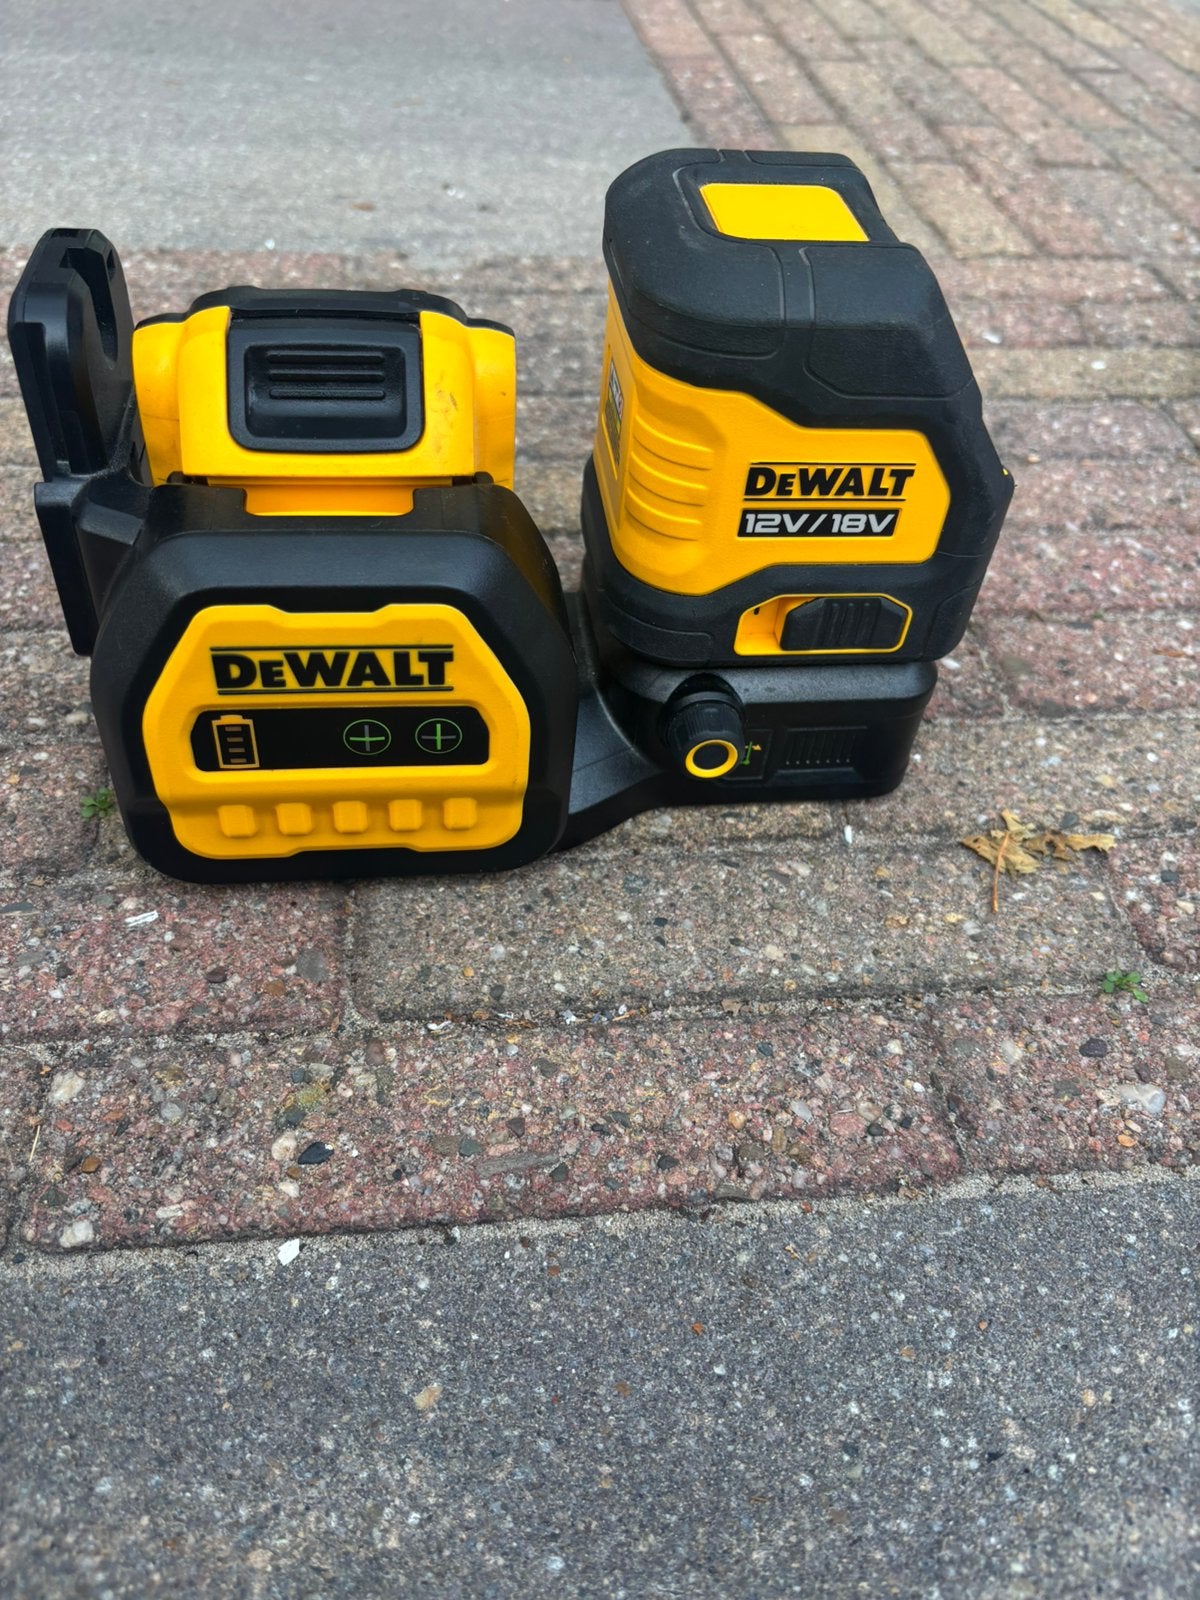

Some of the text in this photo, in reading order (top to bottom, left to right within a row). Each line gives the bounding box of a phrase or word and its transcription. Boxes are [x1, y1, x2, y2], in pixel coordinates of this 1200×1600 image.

[744, 467, 915, 497] DEWALT
[745, 513, 896, 534] 12V/18V
[211, 651, 454, 688] DEWALT
